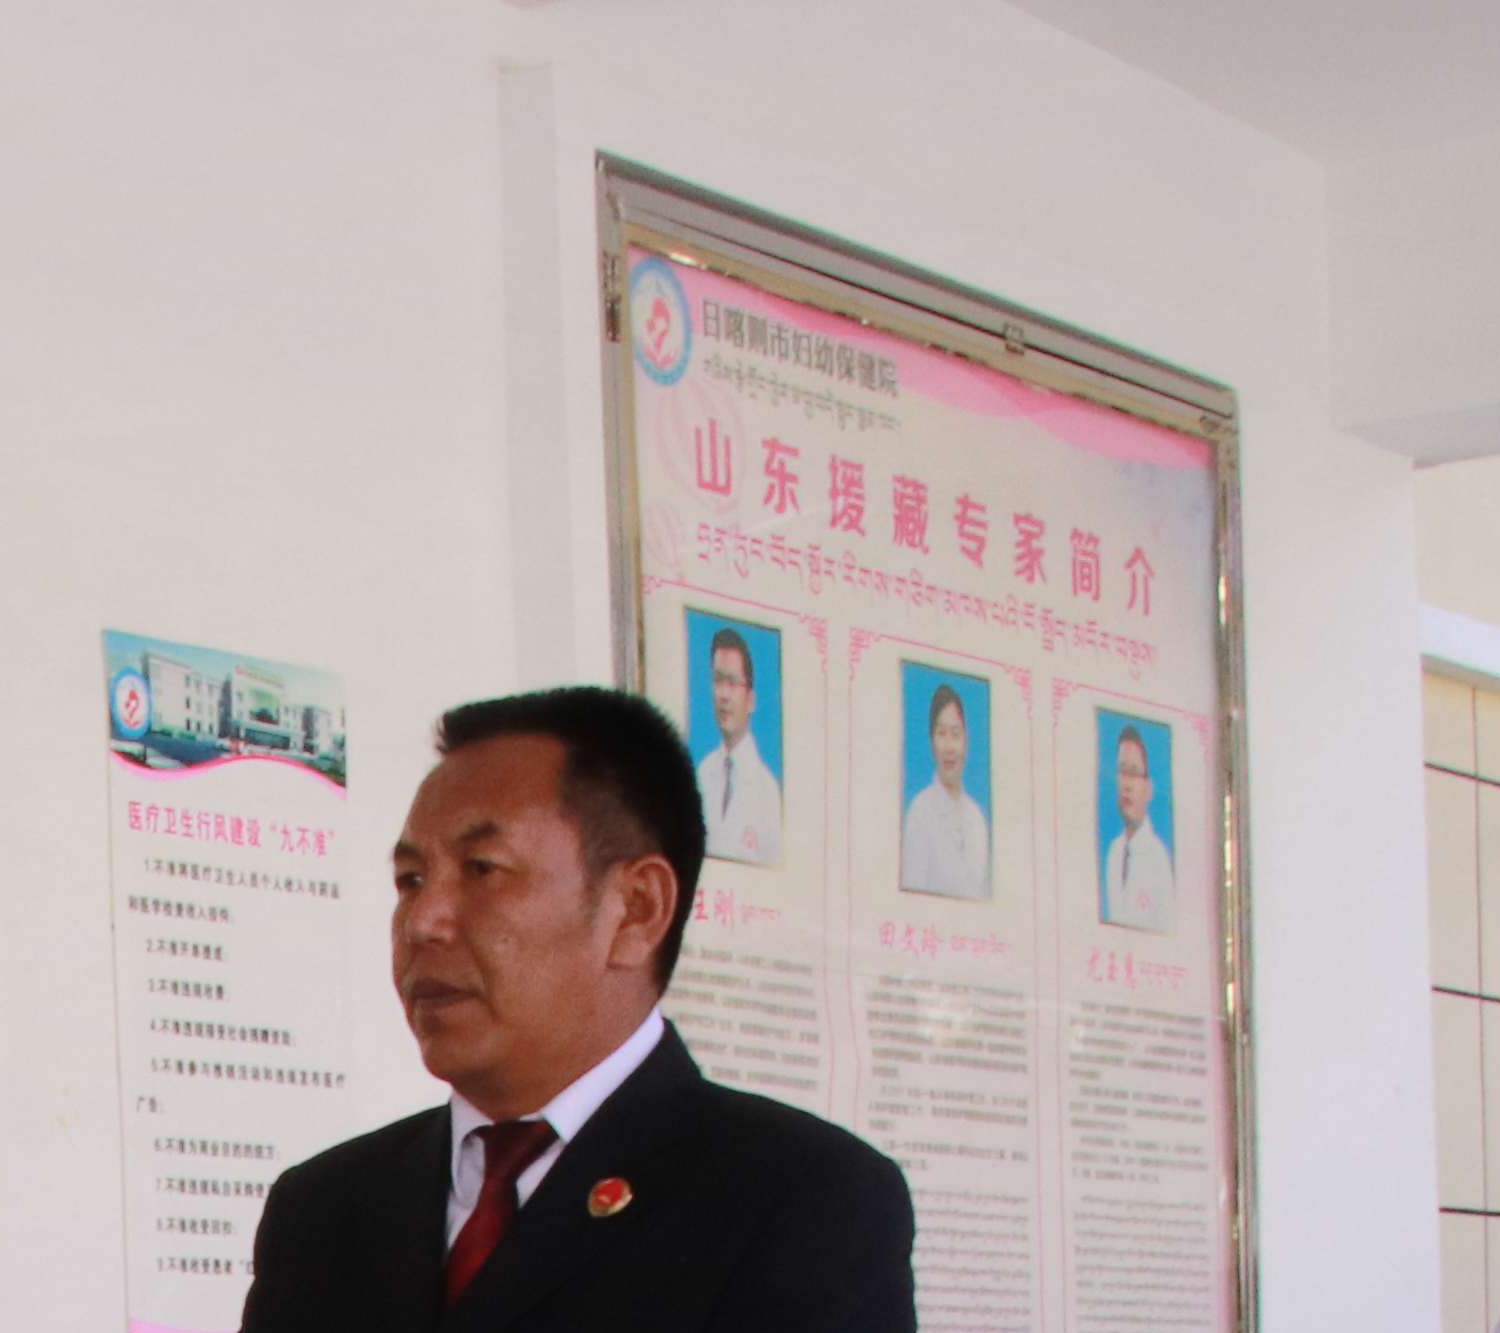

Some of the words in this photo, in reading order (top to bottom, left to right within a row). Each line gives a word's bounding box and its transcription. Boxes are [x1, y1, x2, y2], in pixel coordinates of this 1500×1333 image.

[694, 418, 1157, 616] 山东援藏专家简介
